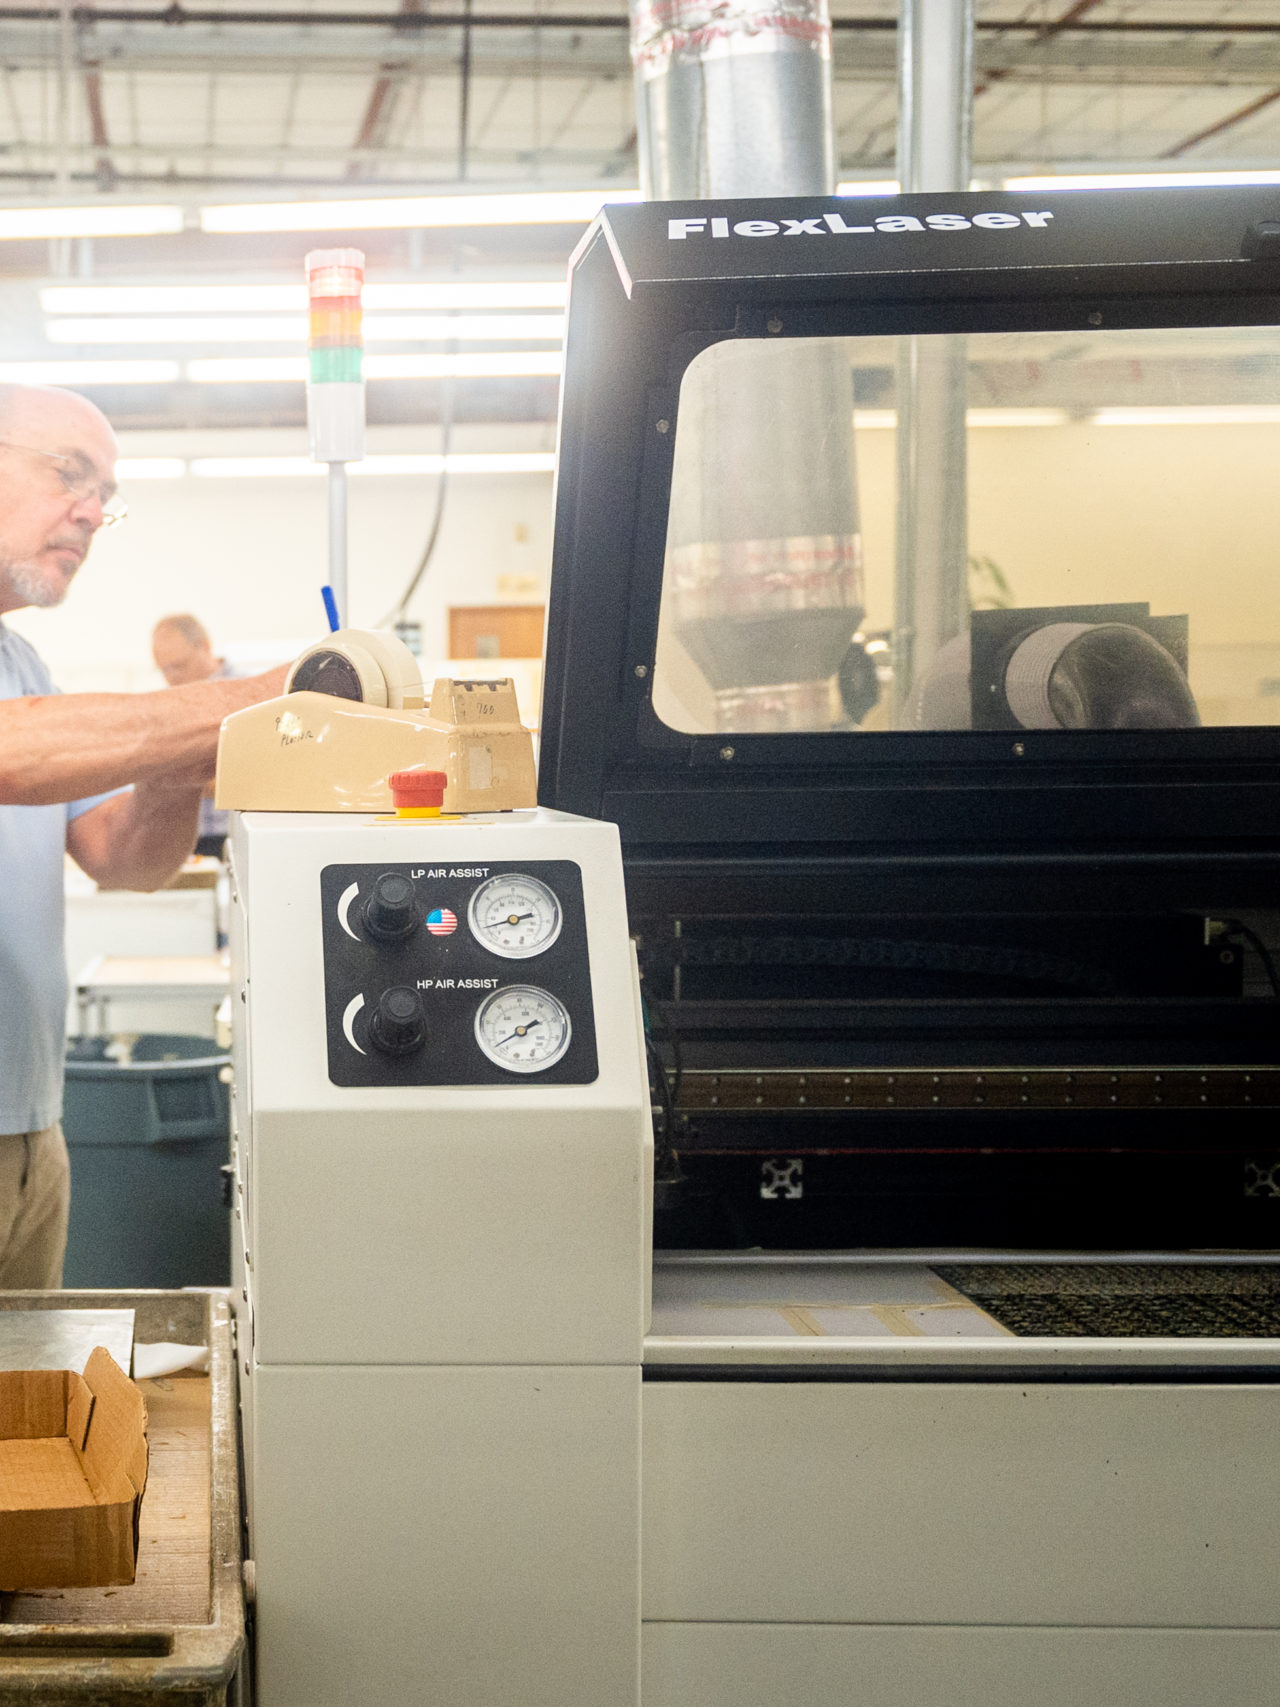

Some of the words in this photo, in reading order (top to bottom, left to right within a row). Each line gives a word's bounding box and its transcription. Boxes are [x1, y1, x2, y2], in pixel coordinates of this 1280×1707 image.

[668, 211, 1054, 239] FlexLaser
[411, 869, 426, 879] LP
[427, 869, 447, 878] AIR
[448, 868, 490, 878] ASSIST
[416, 979, 433, 989] HP
[435, 979, 455, 989] AIR
[457, 979, 499, 989] ASSIST
